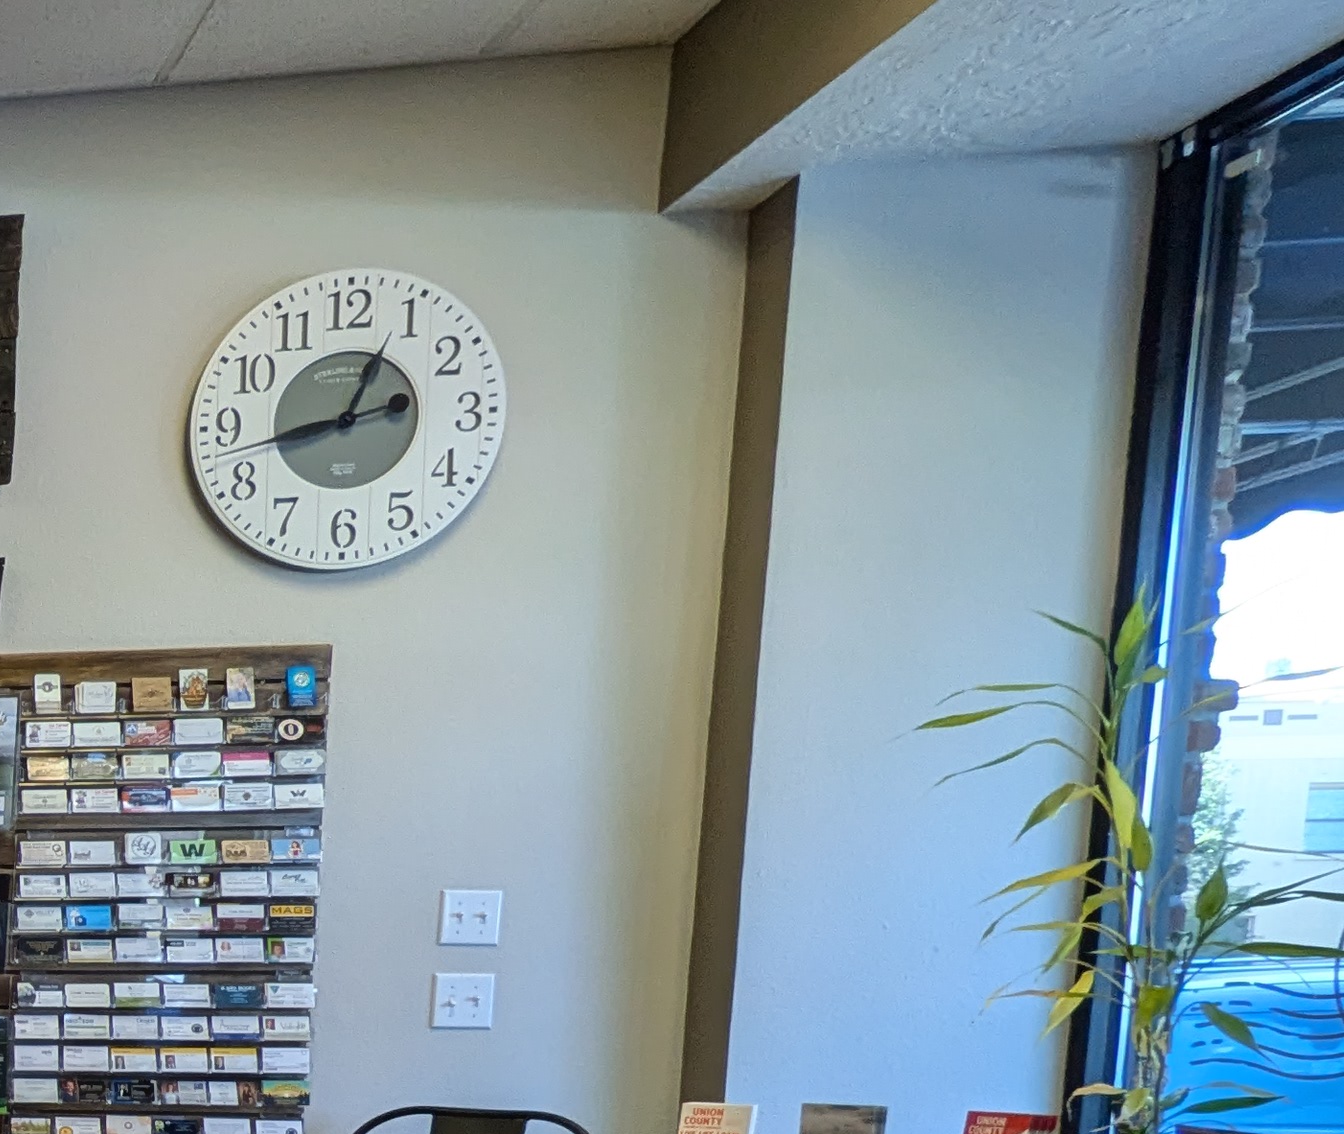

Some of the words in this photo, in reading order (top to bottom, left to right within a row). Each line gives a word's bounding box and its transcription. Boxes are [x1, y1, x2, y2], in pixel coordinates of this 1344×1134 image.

[326, 289, 373, 331] 12
[400, 298, 419, 338] 1
[275, 310, 313, 352] 11
[233, 353, 275, 394] 10
[434, 336, 462, 376] 2
[215, 407, 241, 447] 9
[455, 391, 482, 432] 3
[230, 461, 257, 500] 8
[431, 448, 458, 487] 4
[273, 497, 299, 537] 7
[330, 508, 357, 548] 6
[387, 490, 414, 531] 5
[180, 843, 205, 857] W
[272, 906, 312, 914] MAGS
[684, 1116, 722, 1126] COUNTY
[693, 1107, 724, 1117] UNION
[976, 1115, 1007, 1127] UNION
